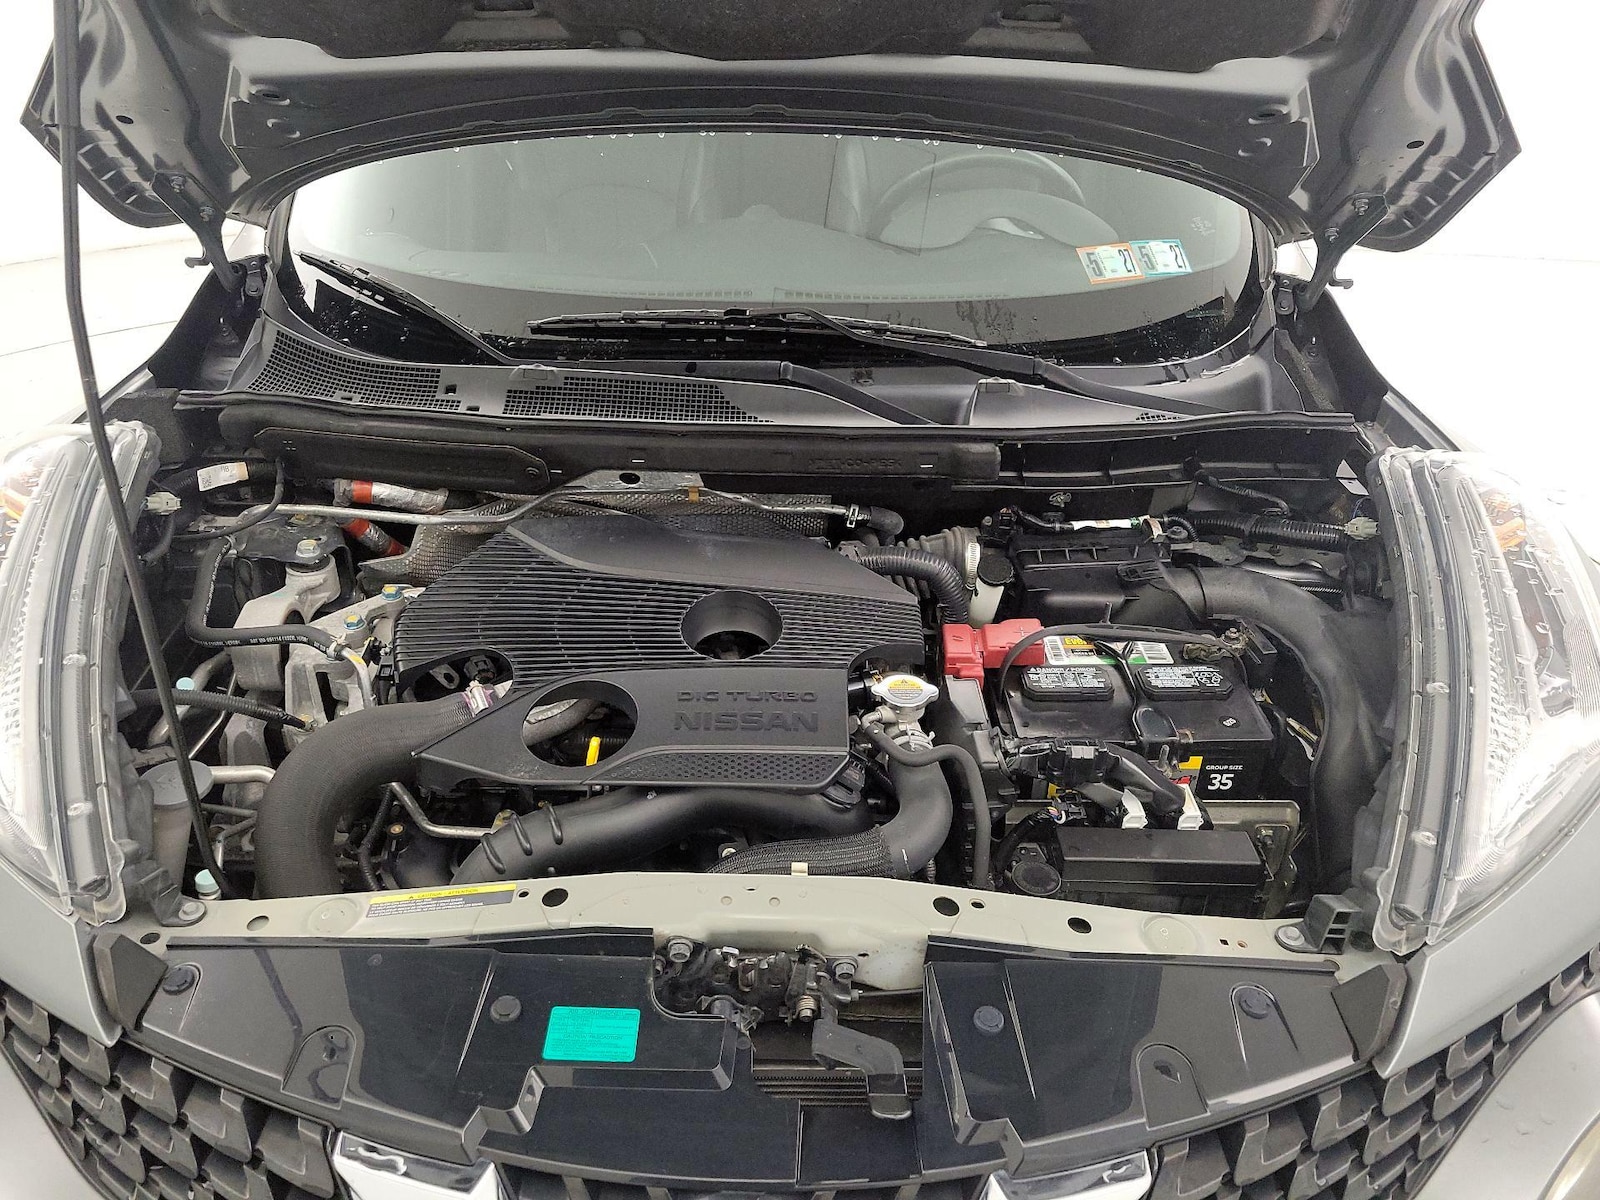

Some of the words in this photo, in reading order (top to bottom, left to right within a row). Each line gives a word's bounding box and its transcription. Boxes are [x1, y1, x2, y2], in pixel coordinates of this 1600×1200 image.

[1086, 252, 1104, 277] 5
[1138, 246, 1157, 271] 5
[726, 690, 818, 702] TURBO
[674, 711, 819, 732] NISSAN
[1207, 773, 1235, 790] 35
